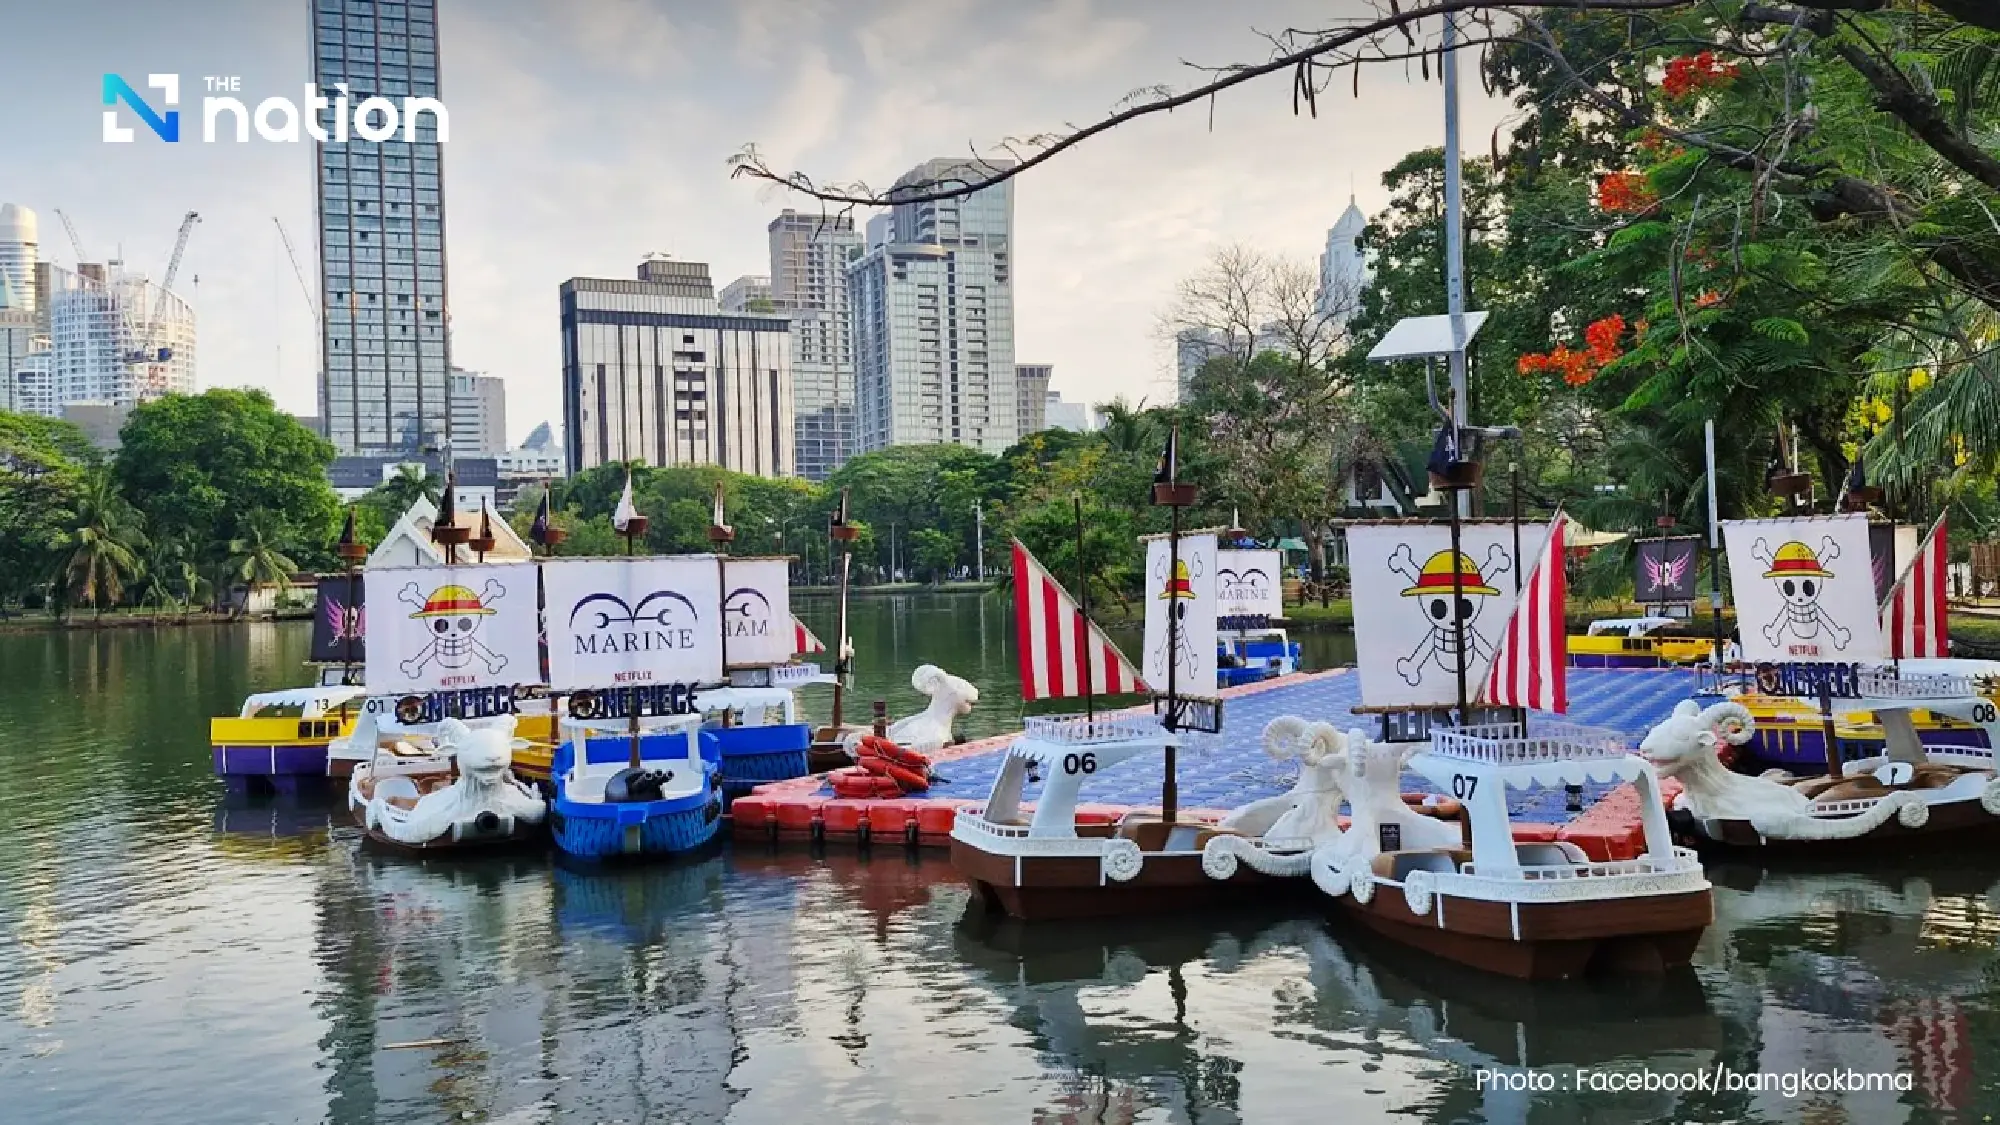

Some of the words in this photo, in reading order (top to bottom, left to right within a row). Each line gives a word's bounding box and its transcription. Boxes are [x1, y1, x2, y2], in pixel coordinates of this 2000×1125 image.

[574, 628, 695, 655] MARINE
[1787, 644, 1819, 657] NETFLIX
[439, 675, 477, 687] NETFLIX
[614, 670, 652, 682] NETFLIX
[314, 698, 329, 712] 13
[367, 698, 385, 714] 01
[1972, 704, 1996, 724] 08
[1063, 752, 1097, 775] 06
[1453, 773, 1479, 801] 07
